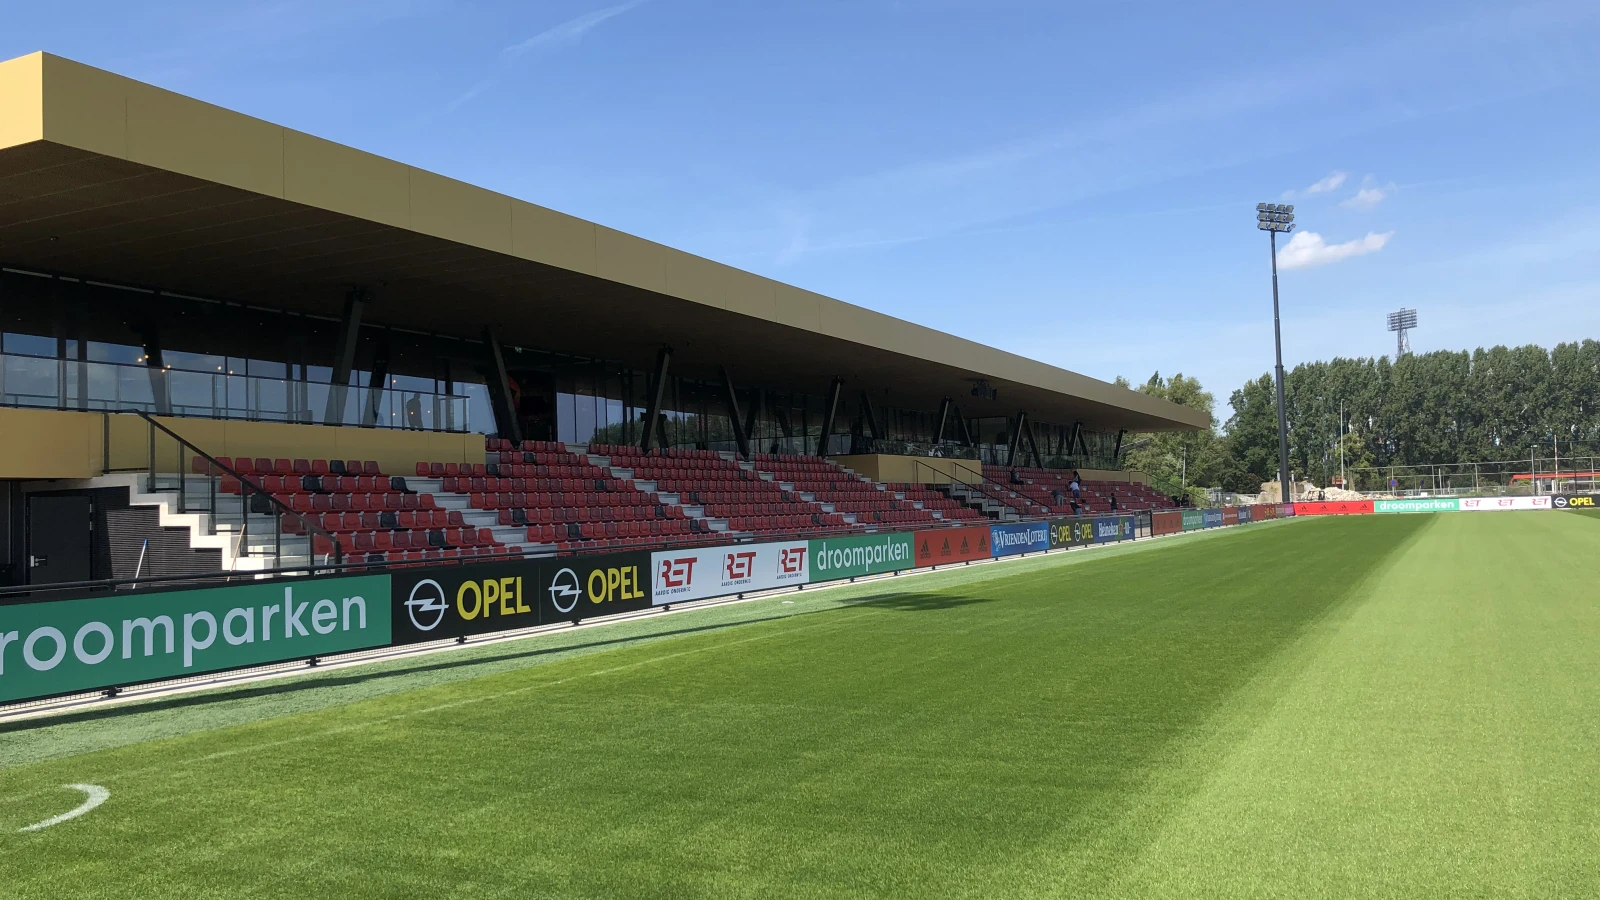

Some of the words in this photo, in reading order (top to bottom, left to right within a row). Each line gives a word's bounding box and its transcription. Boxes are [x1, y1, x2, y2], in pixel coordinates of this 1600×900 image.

[1380, 500, 1455, 510] droomparken
[1569, 497, 1595, 506] OPEL
[1058, 525, 1072, 542] OPEL
[1081, 523, 1093, 539] OPEL
[818, 536, 909, 571] droomparken
[587, 566, 644, 604] OPEL
[457, 576, 531, 620] OPEL
